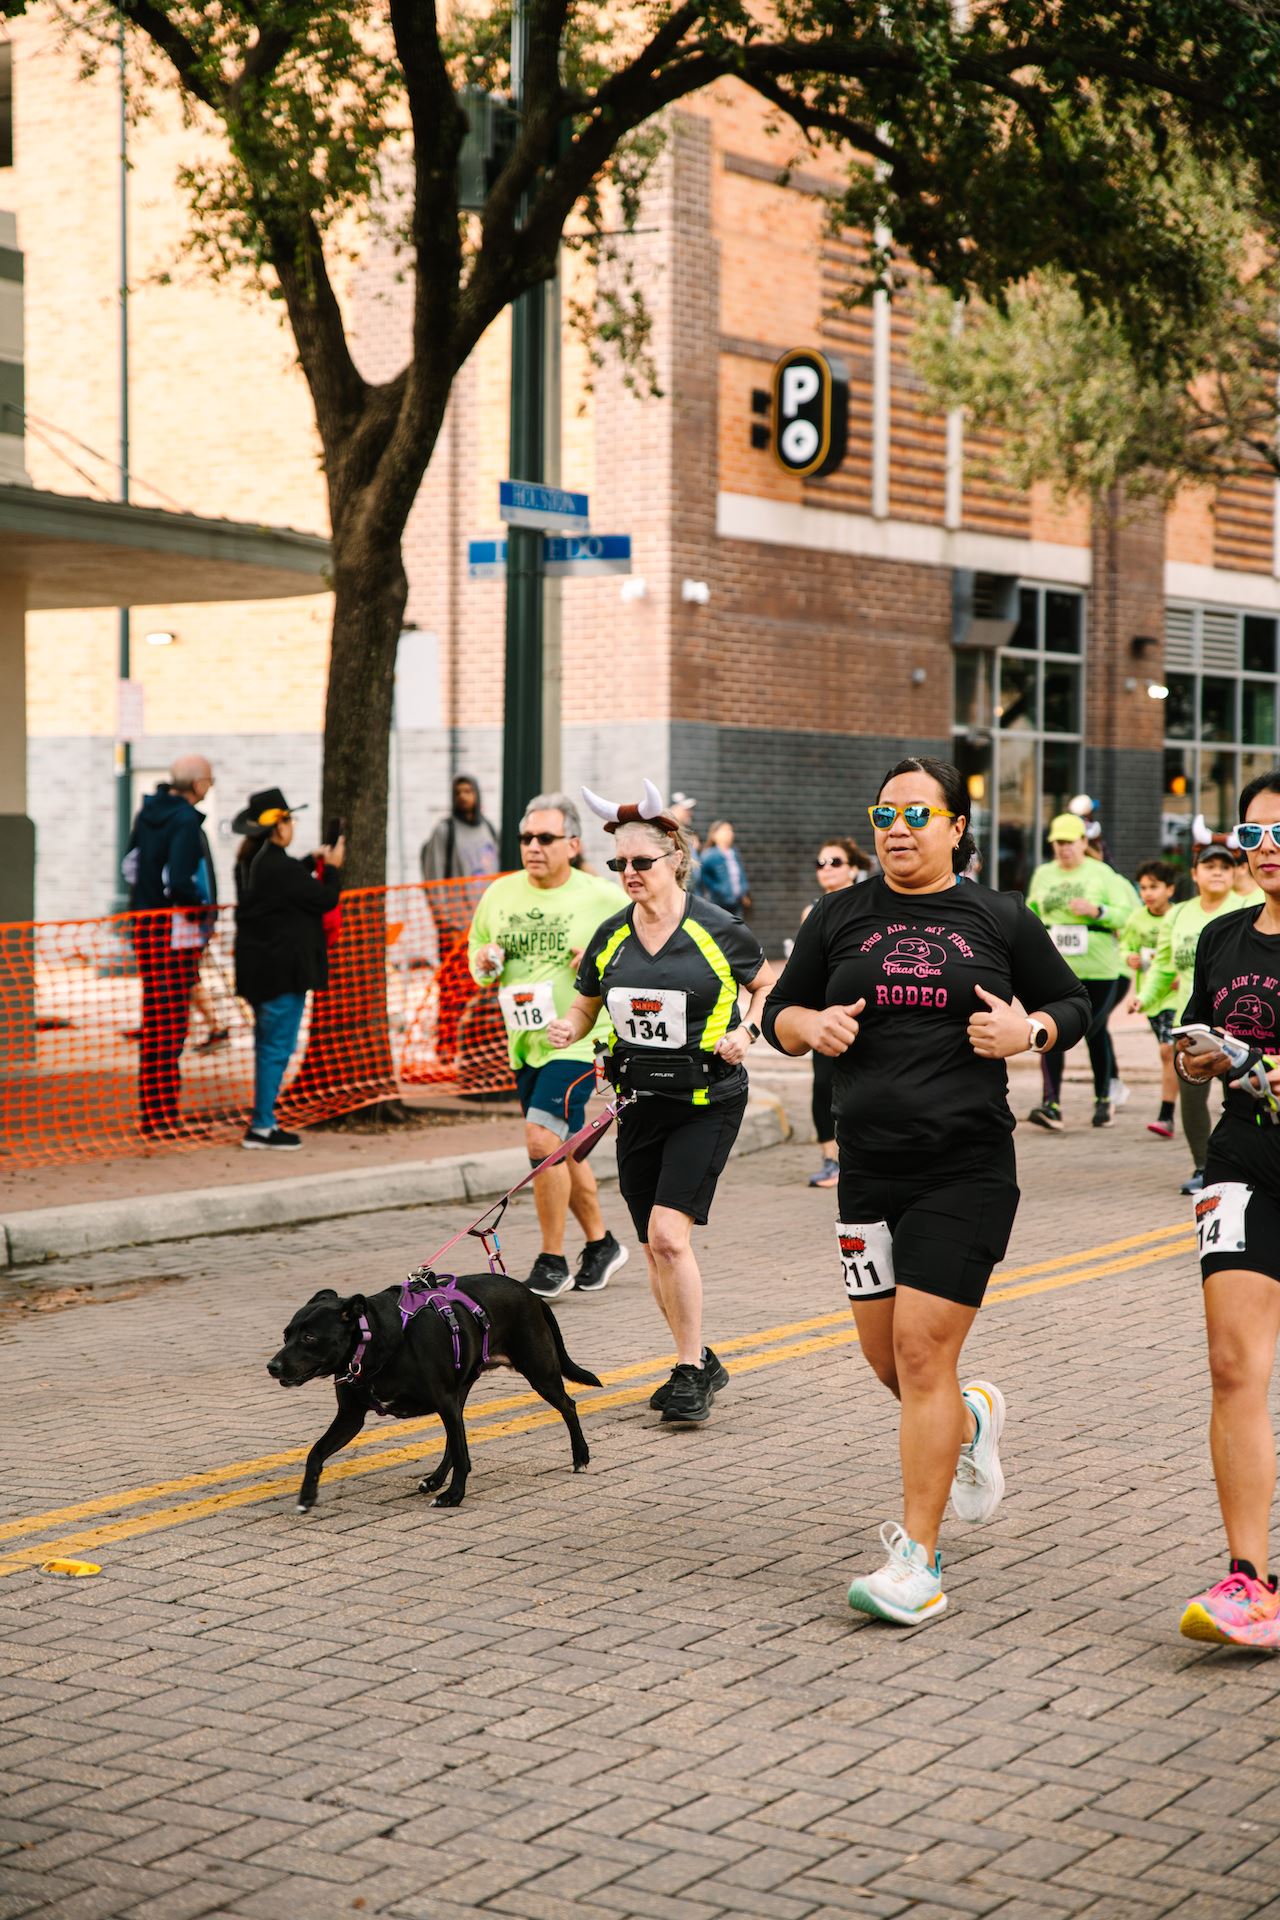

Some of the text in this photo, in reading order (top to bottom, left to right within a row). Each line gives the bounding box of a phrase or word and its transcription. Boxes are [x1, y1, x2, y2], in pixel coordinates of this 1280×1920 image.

[860, 932, 882, 953] THIS
[947, 932, 974, 959] FIRST
[882, 962, 942, 978] Texas Chica
[875, 984, 948, 1008] RODEO
[513, 1008, 543, 1026] 118
[625, 1018, 669, 1042] 134
